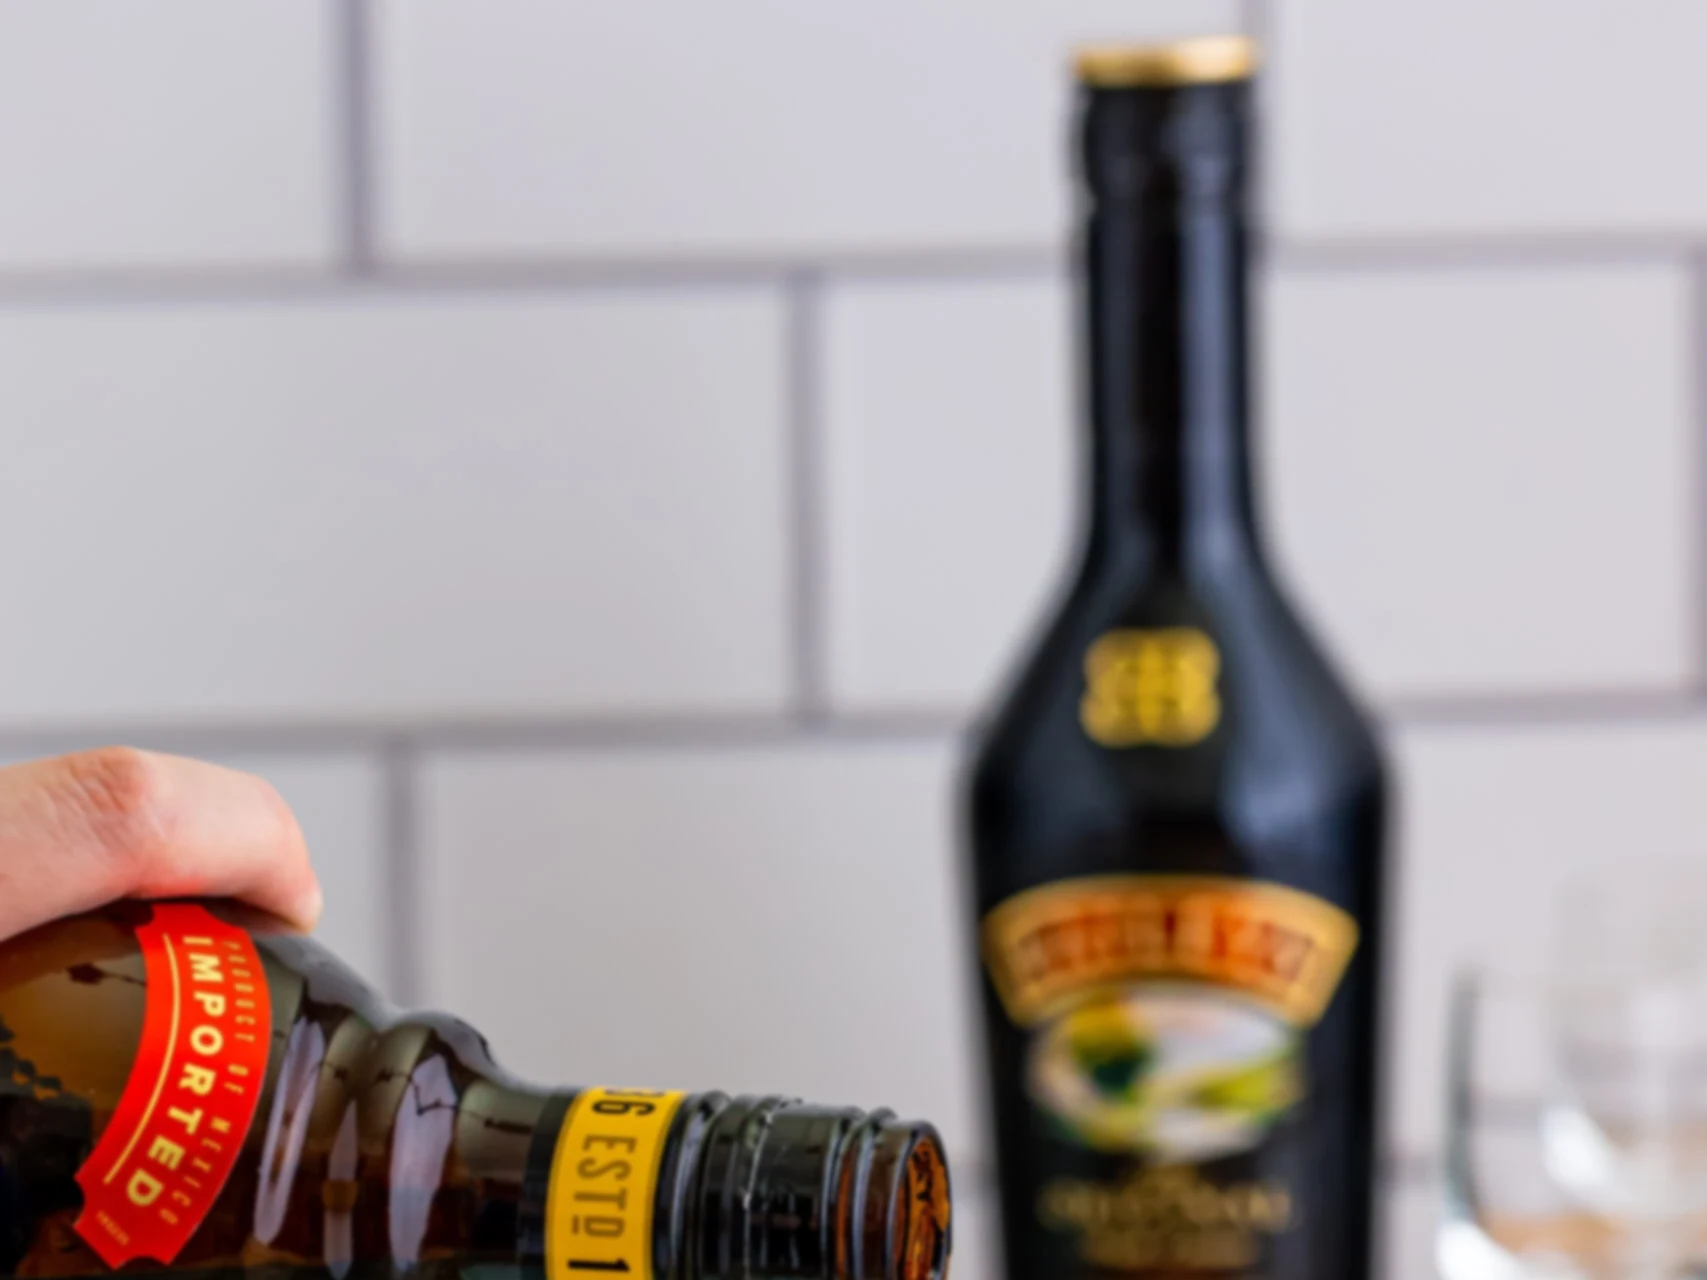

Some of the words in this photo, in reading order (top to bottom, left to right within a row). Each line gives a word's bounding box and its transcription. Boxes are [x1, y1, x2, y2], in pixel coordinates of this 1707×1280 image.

[222, 938, 256, 1044] PRODUCT
[126, 934, 227, 1207] IMPORTED
[223, 1063, 249, 1096] OF
[158, 1115, 232, 1226] MEXICO
[570, 1133, 638, 1239] ESTD
